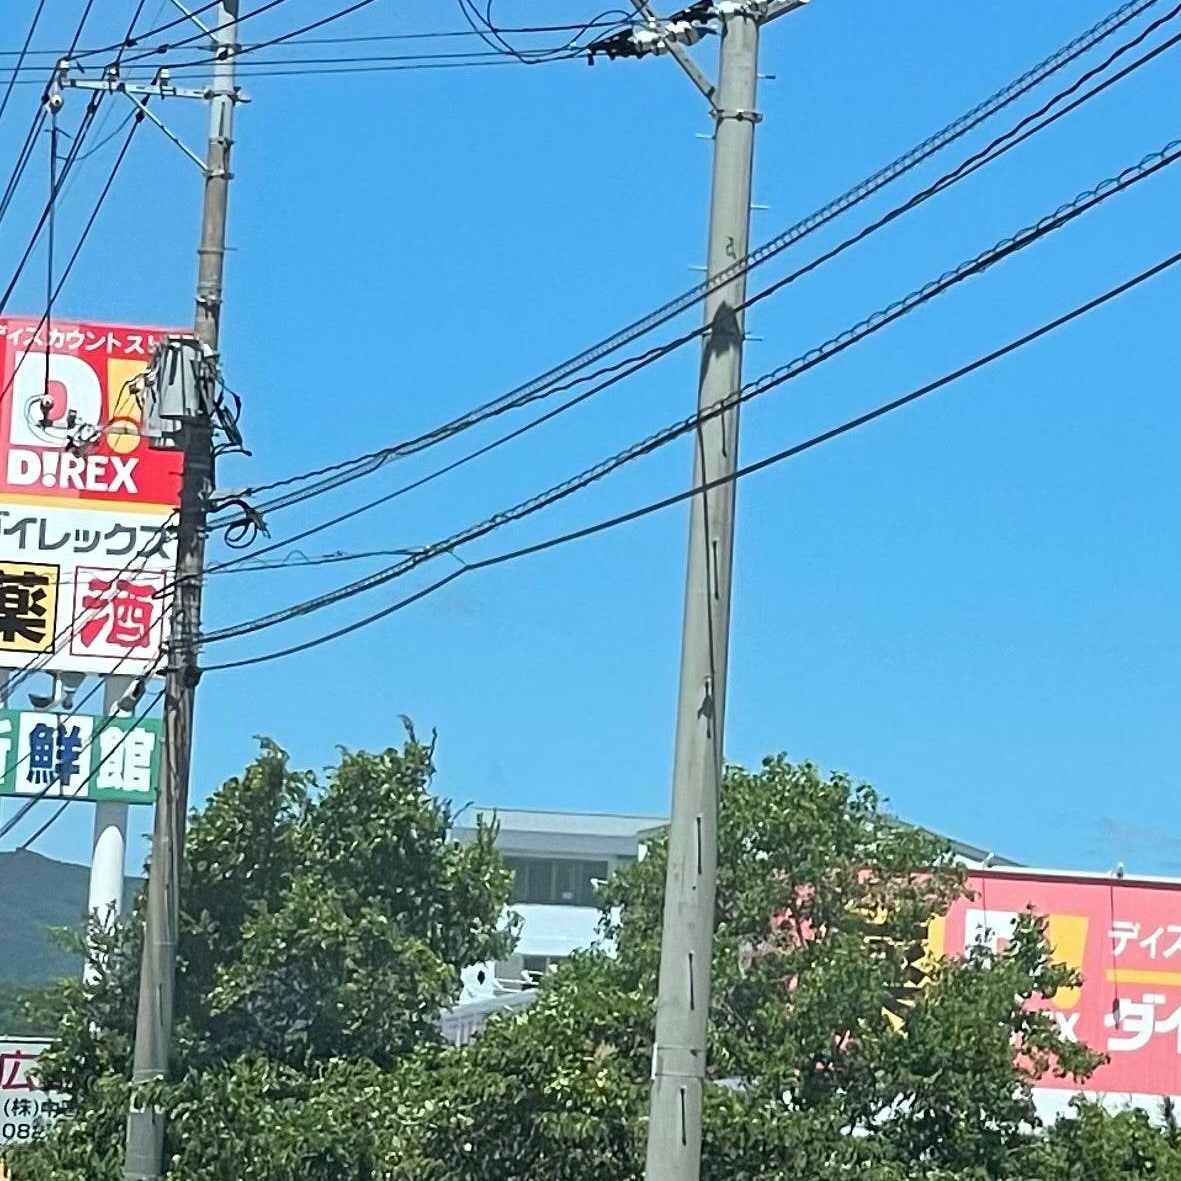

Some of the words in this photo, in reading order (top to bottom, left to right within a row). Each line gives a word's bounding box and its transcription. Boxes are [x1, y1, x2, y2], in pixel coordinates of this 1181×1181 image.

[0, 324, 121, 354] ィスカウント
[0, 511, 170, 559] イレックス
[80, 578, 156, 648] 酒
[0, 719, 156, 792] 鮮館
